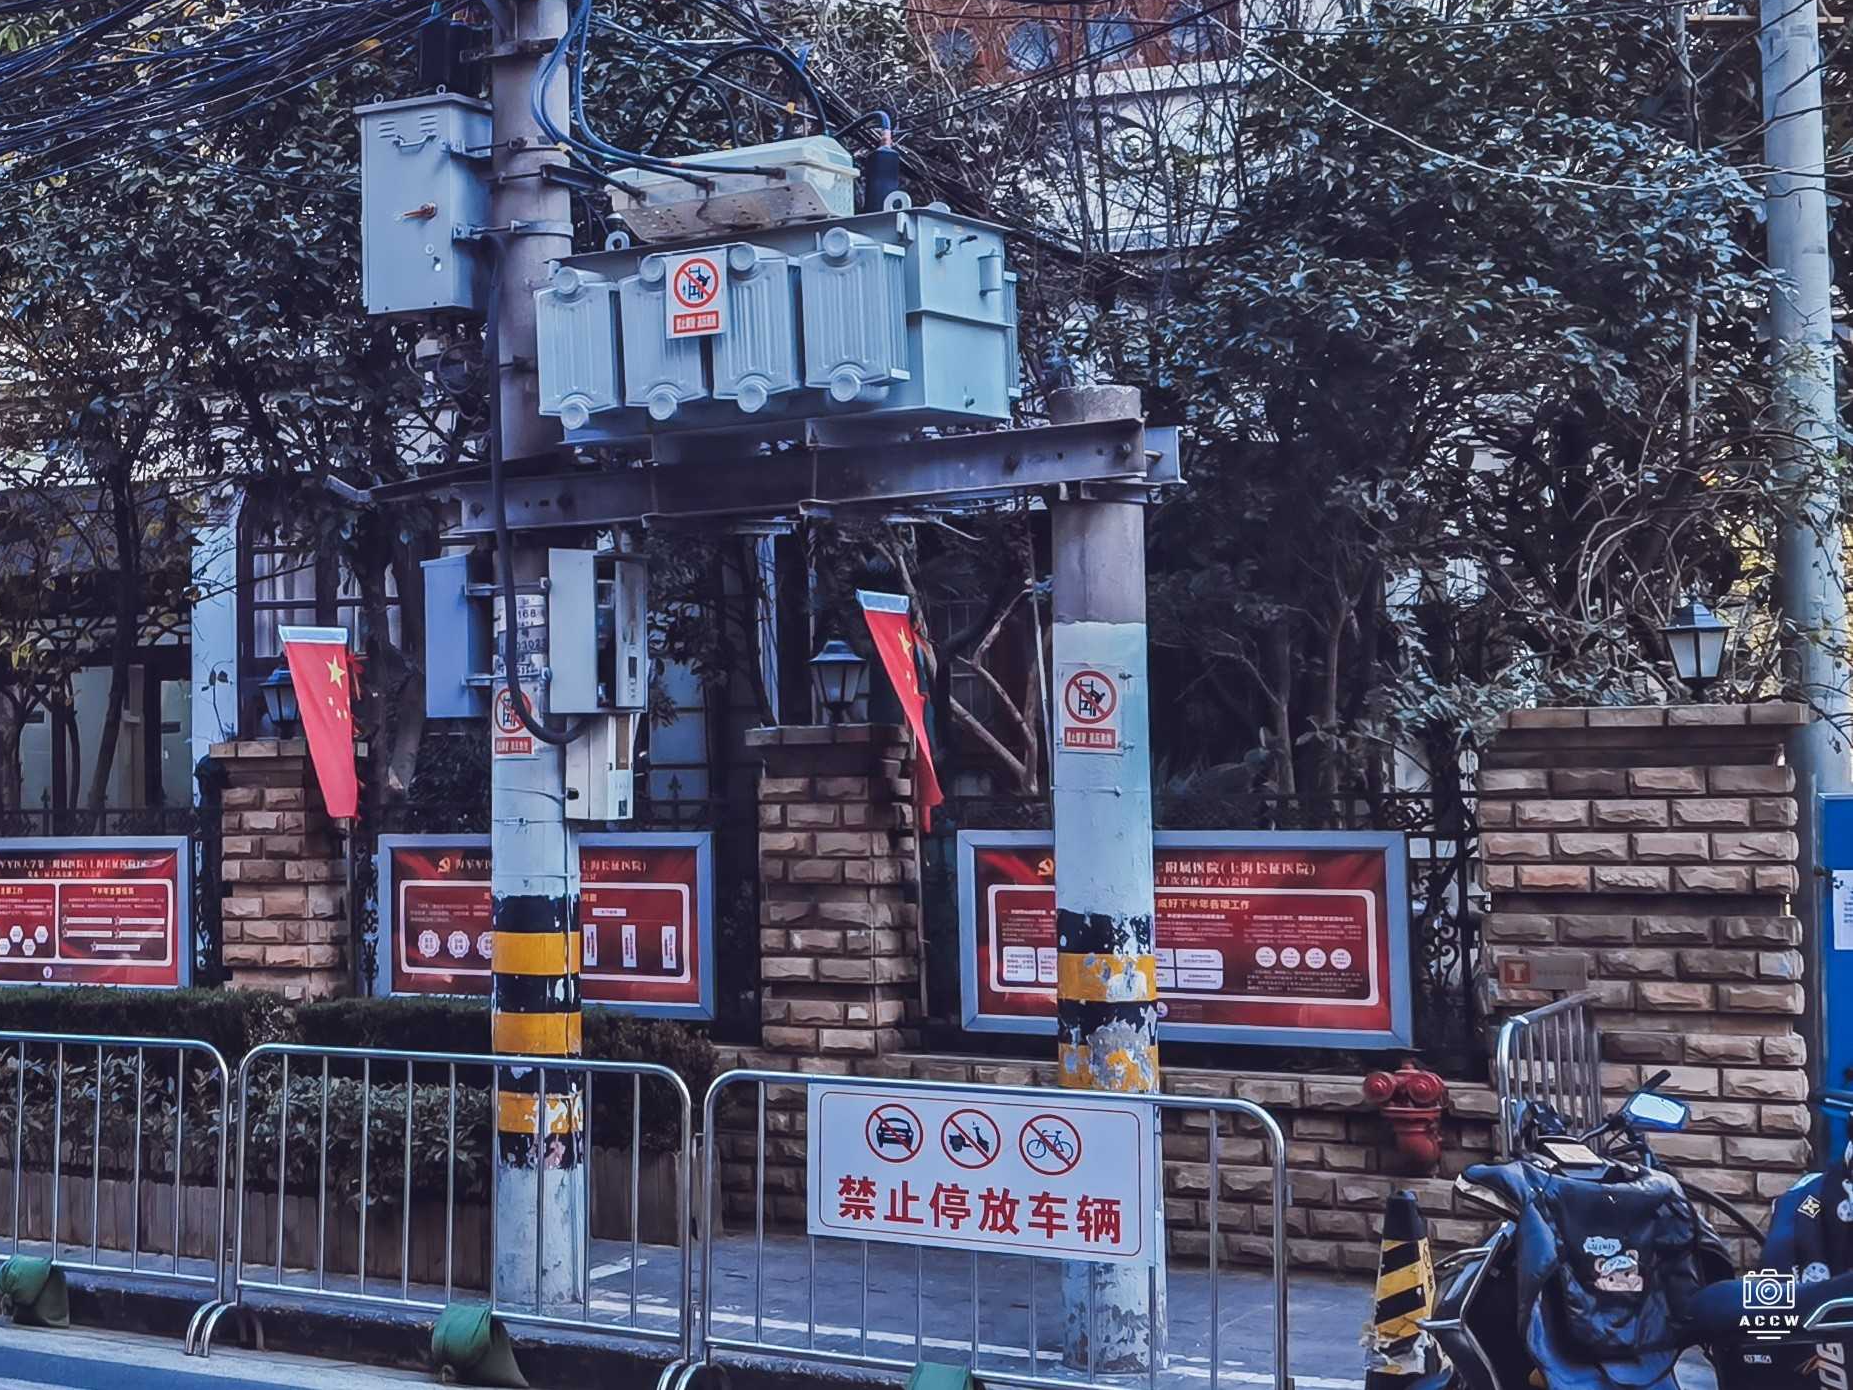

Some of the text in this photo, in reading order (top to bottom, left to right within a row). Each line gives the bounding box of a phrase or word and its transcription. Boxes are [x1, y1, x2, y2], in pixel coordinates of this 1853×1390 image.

[837, 1174, 1121, 1244] 禁止停放车辆
